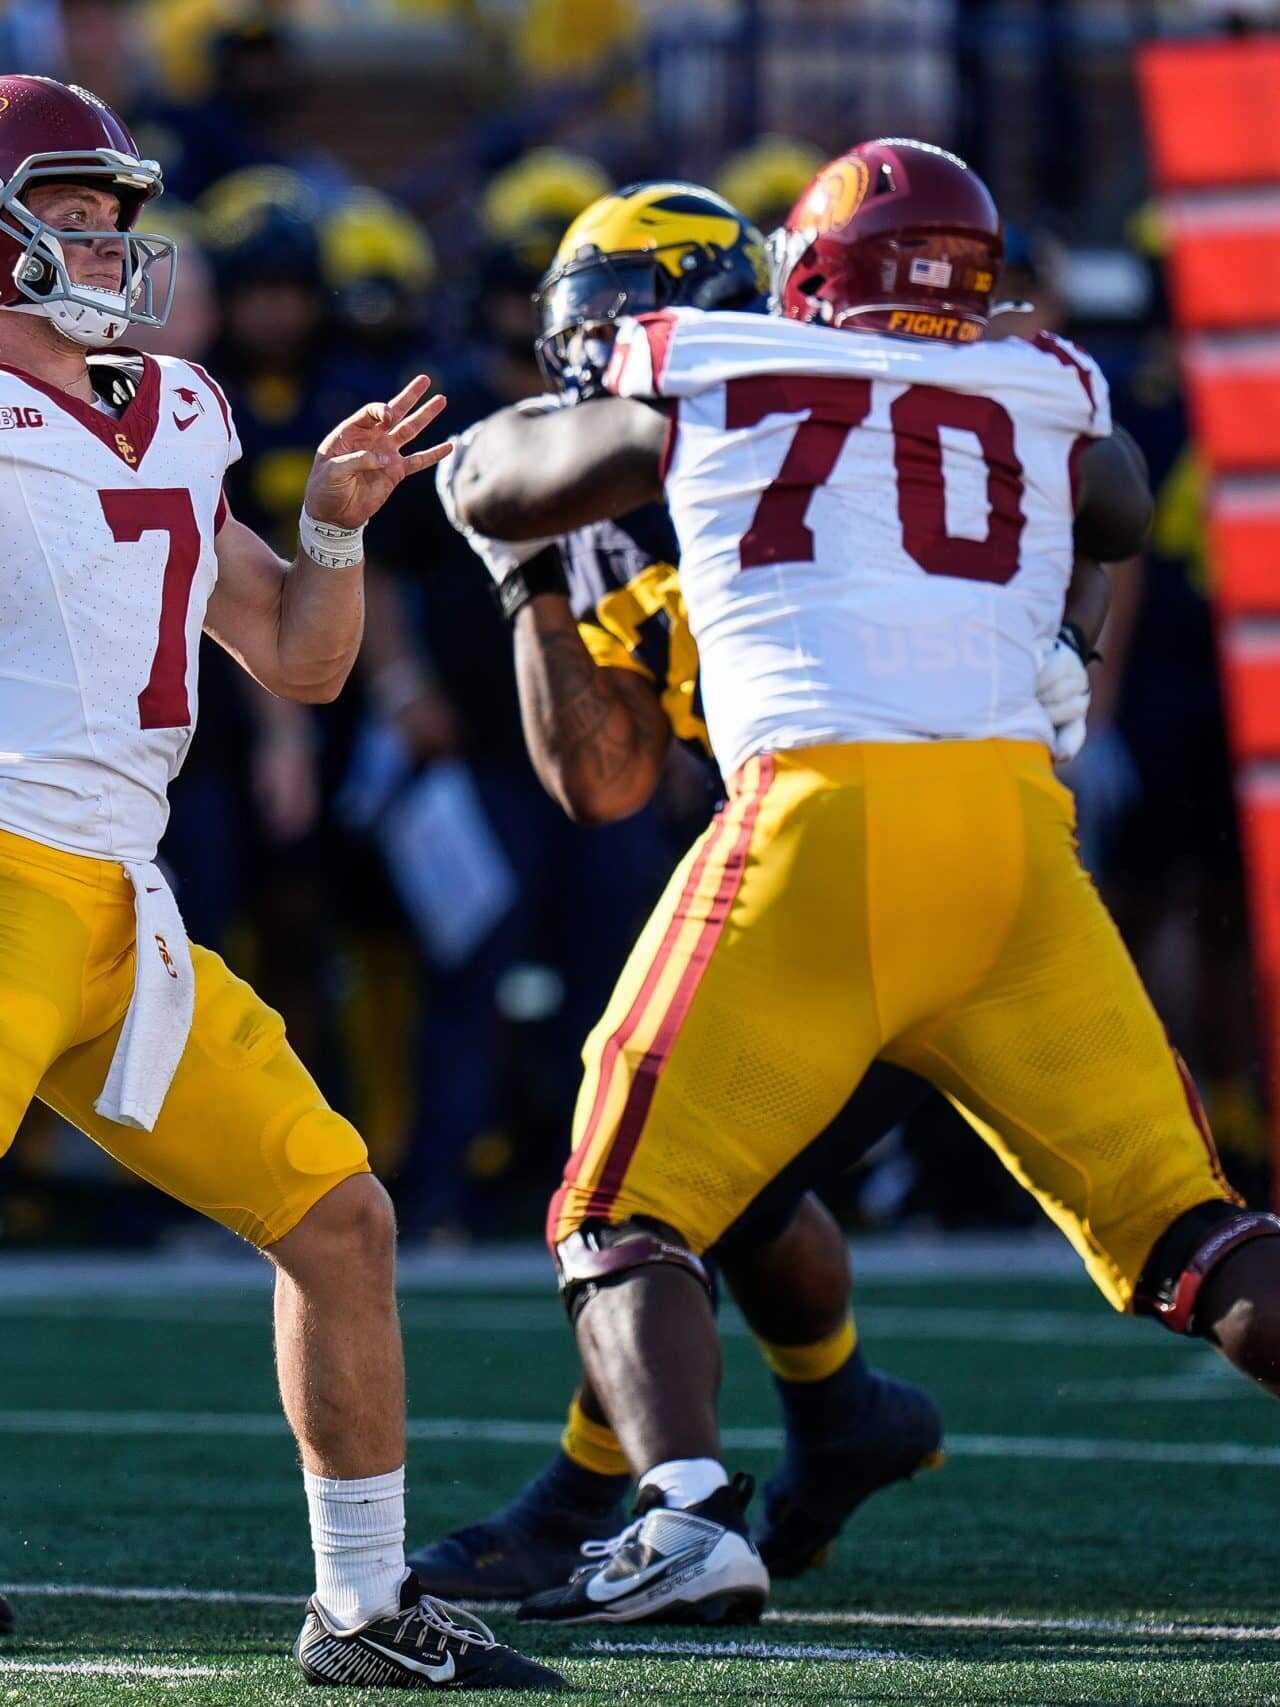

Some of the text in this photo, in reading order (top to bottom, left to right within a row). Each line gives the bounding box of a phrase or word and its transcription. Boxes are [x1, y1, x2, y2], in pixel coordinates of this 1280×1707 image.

[888, 310, 958, 338] FIGHT
[724, 374, 1027, 586] 70
[97, 488, 201, 729] 7
